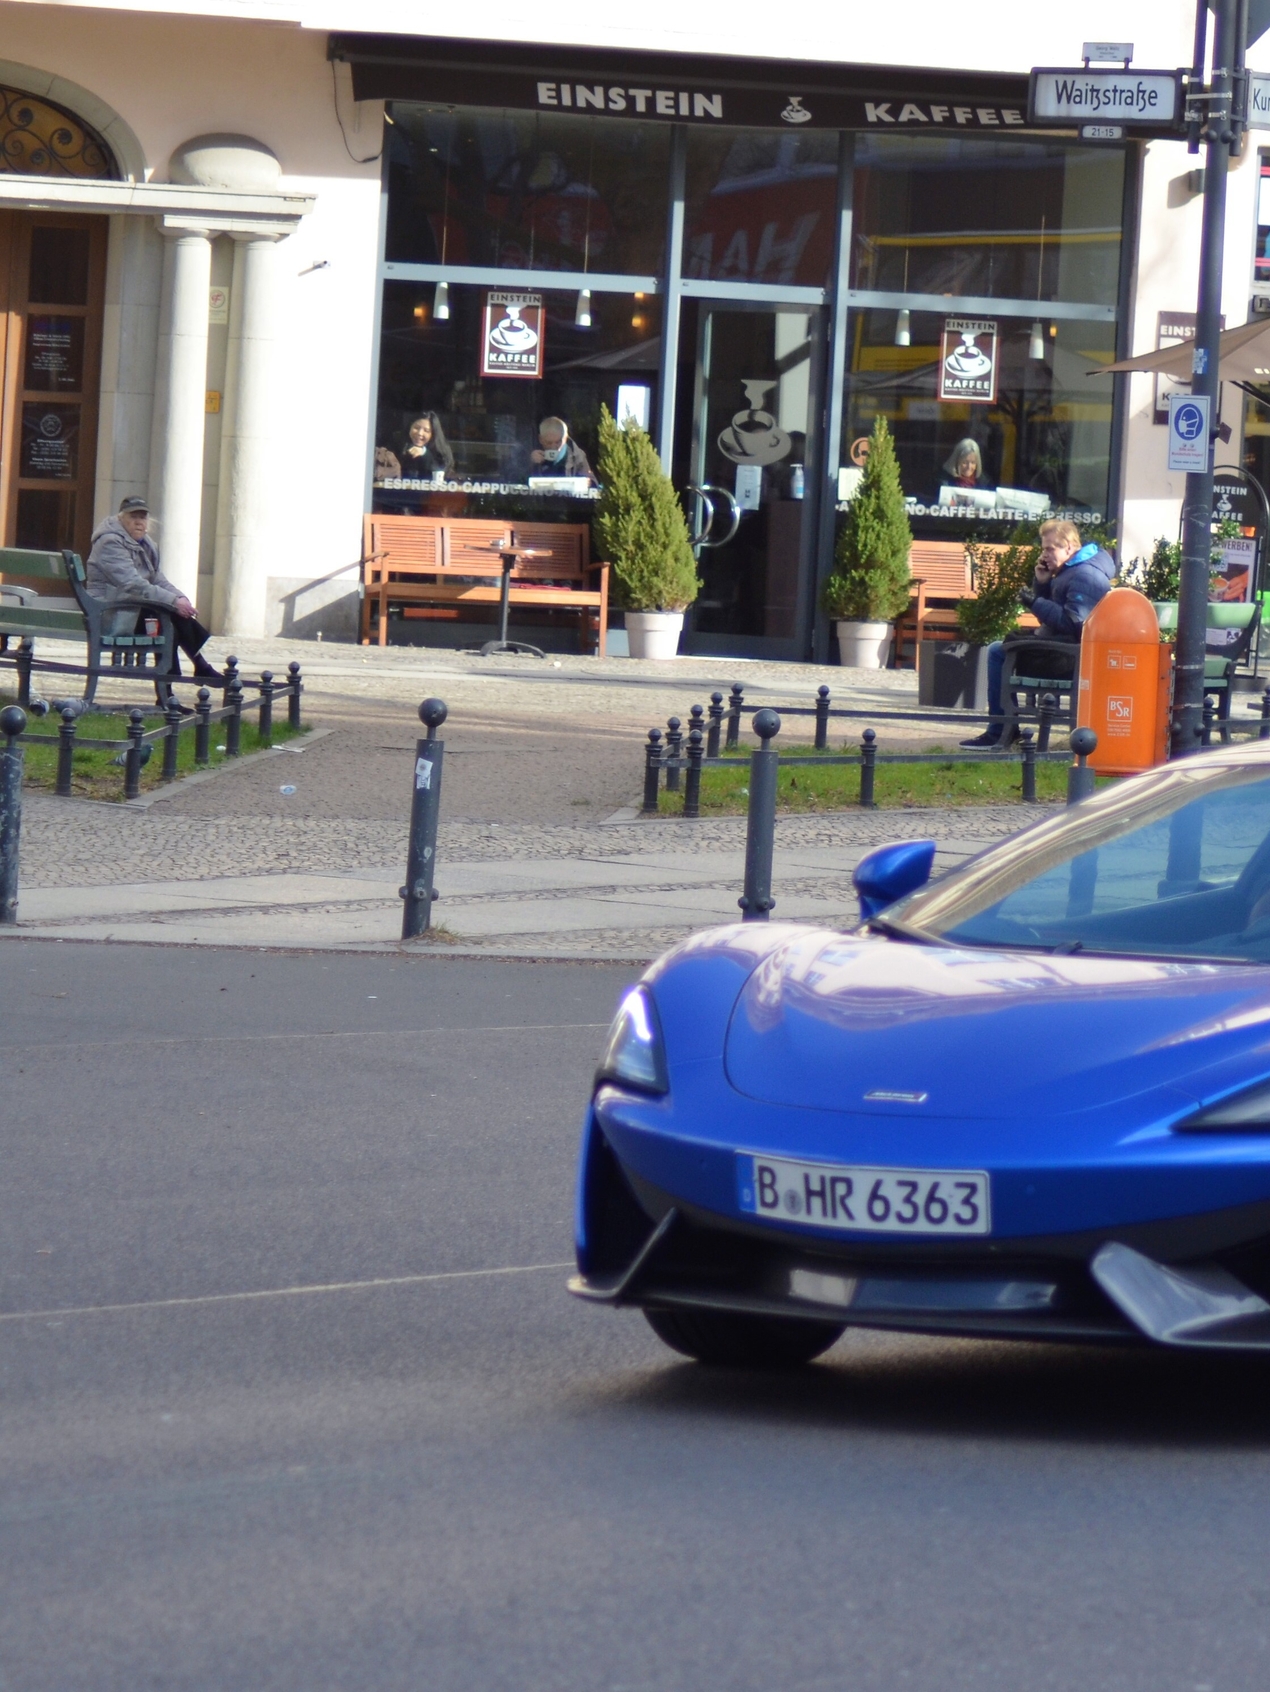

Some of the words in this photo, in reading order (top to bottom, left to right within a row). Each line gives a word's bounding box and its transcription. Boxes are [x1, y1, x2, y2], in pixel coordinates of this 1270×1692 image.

[537, 82, 723, 118] EINSTEIN
[864, 102, 1025, 125] KAFFEE
[1091, 127, 1114, 137] 21-15
[490, 293, 540, 303] EINSTEIN
[946, 321, 995, 330] EINSTEIN
[489, 353, 536, 364] KAFFEE
[945, 379, 990, 389] KAFFEE
[384, 478, 457, 492] ESPRESSO
[462, 481, 554, 497] CAPPUCCINO
[1213, 485, 1247, 496] NSTEIN
[979, 507, 1022, 520] LATTE
[1211, 511, 1243, 521] AFFEE
[1110, 701, 1130, 717] BSR
[758, 1166, 779, 1209] B
[803, 1172, 855, 1221] HR
[867, 1179, 979, 1226] 6363
